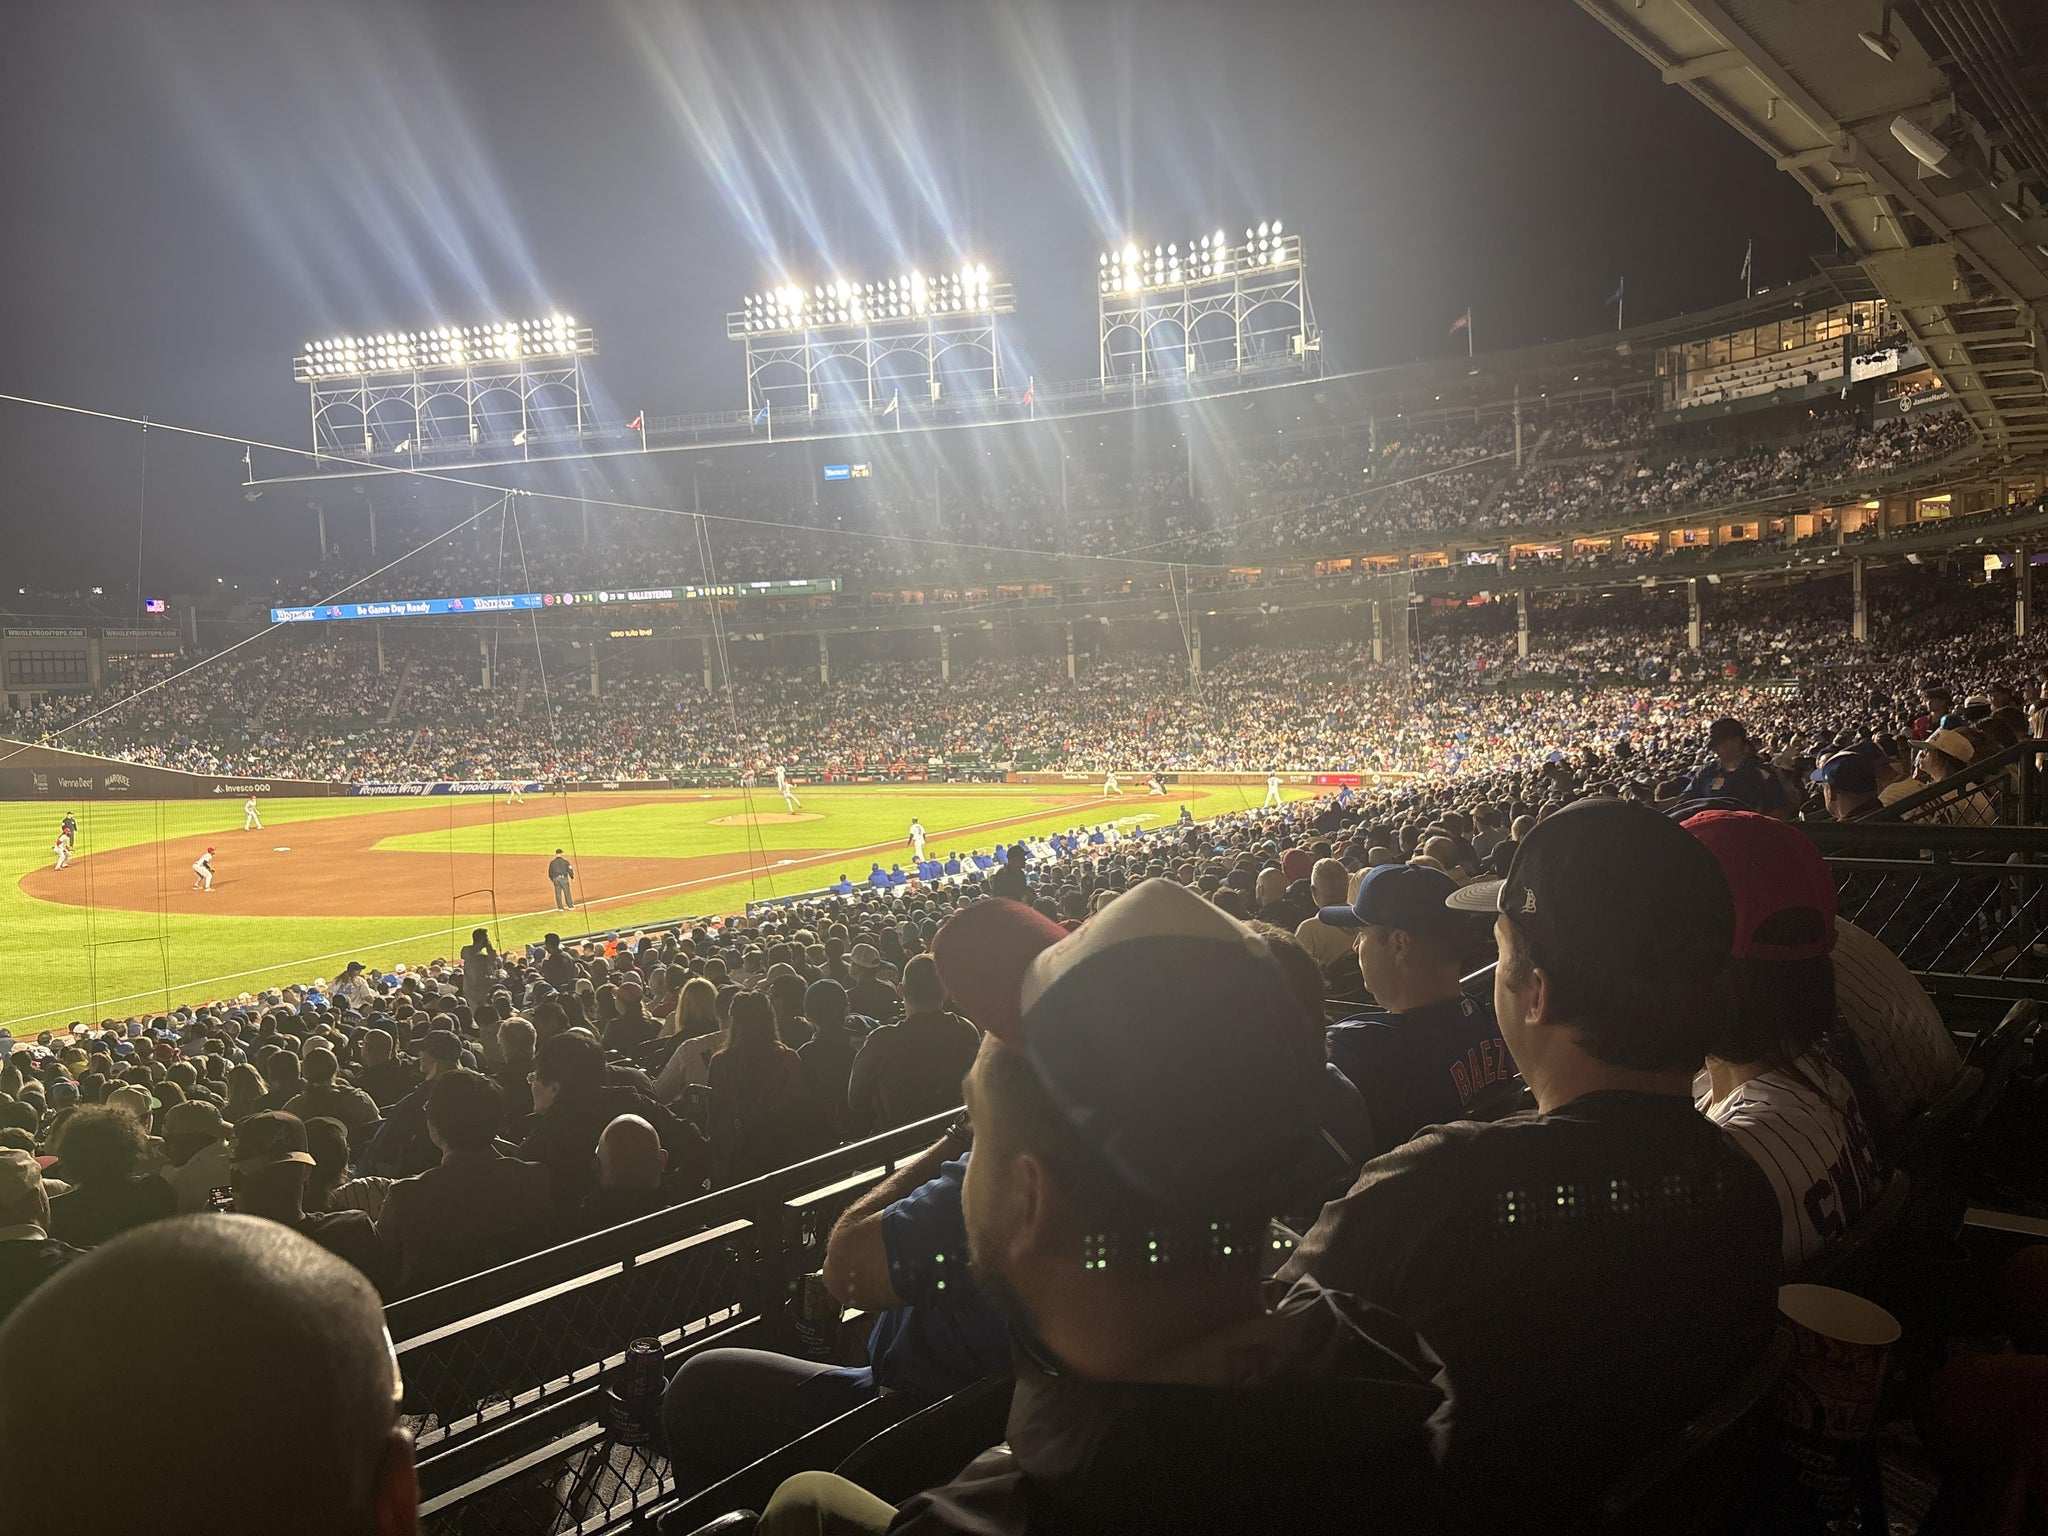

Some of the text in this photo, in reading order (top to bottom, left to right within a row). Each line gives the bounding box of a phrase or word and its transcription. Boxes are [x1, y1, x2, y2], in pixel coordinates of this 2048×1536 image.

[627, 589, 673, 600] BALLESTEROS
[356, 601, 430, 615] Be Game Day Ready
[104, 773, 131, 788] MARQUEE
[225, 783, 254, 792] Invesco
[359, 783, 422, 796] Reynolds Wrap
[448, 782, 490, 794] Reynolds
